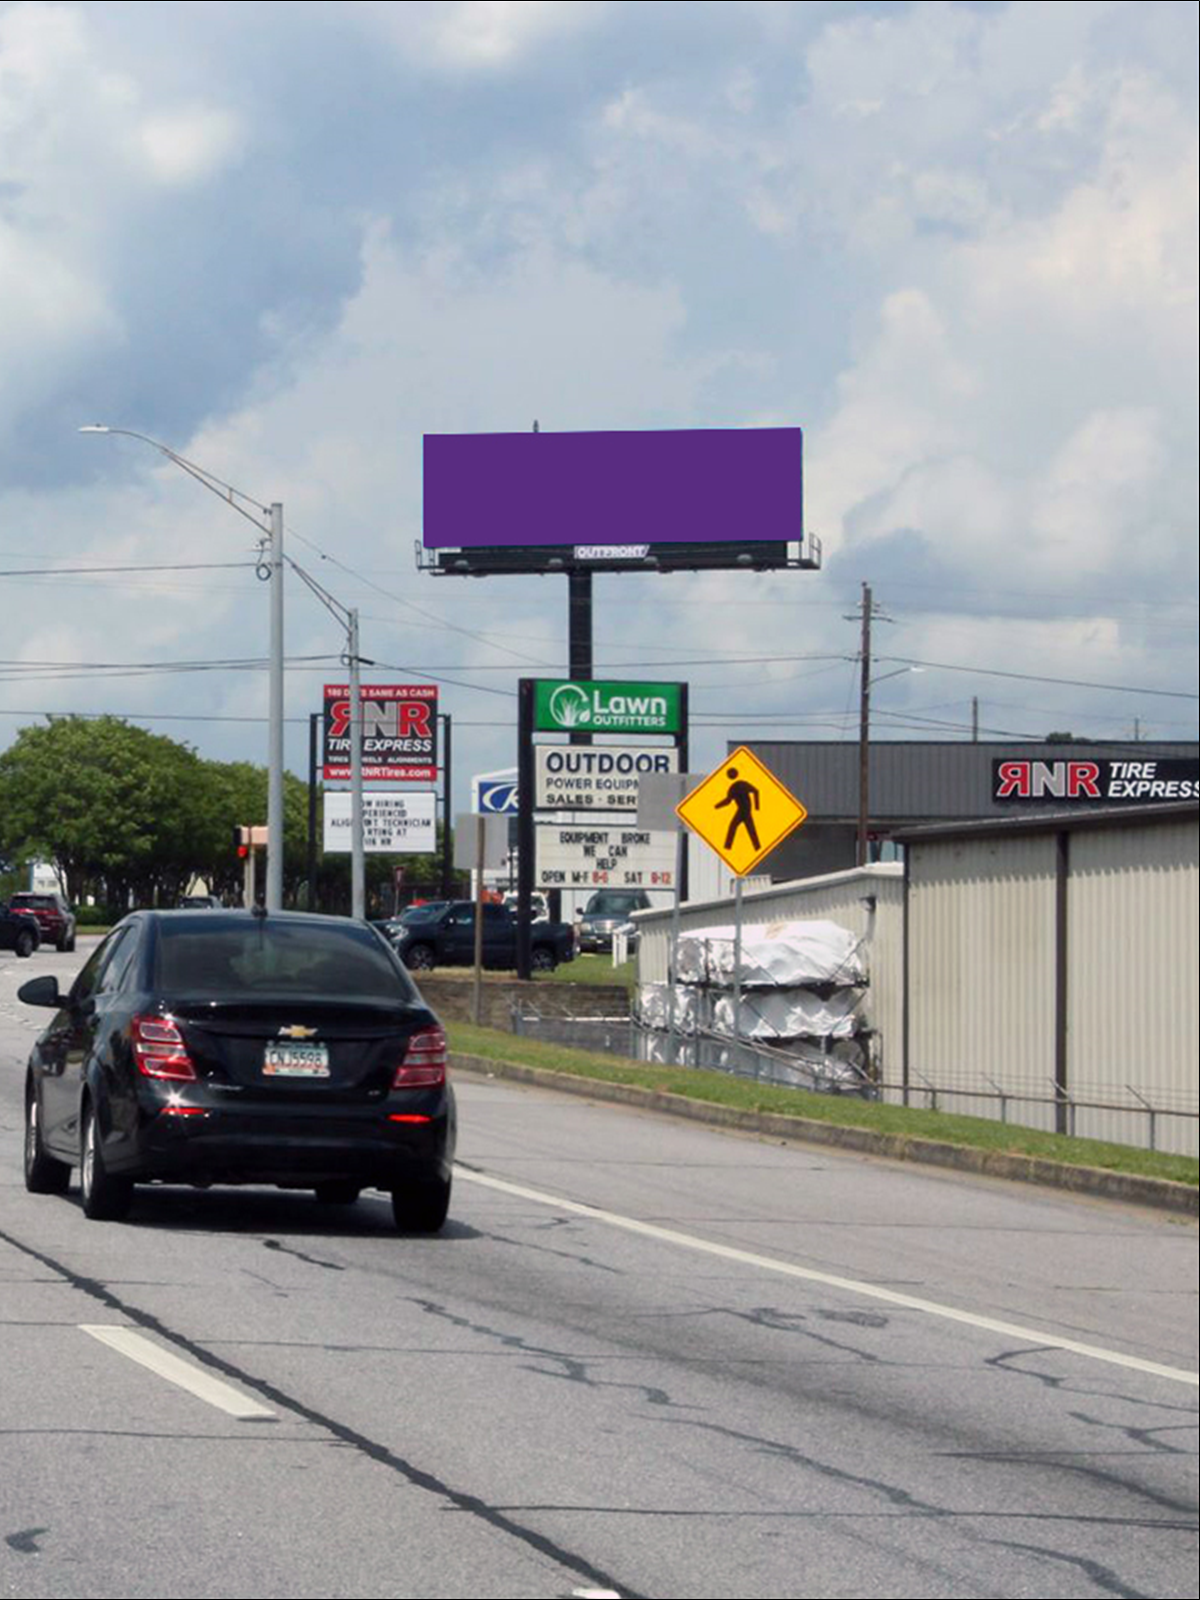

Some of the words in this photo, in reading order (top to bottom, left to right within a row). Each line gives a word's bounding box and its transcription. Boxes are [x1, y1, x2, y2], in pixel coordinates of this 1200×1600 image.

[577, 546, 646, 558] OUTFRONT
[593, 690, 667, 715] Lawn
[592, 715, 667, 727] OUTFITTERS
[328, 739, 351, 751] TIR
[363, 739, 433, 751] EXPRESS
[546, 752, 670, 774] OUTDOOR
[329, 766, 431, 777] wwwRNRTires.com
[1109, 762, 1157, 779] TIRE
[546, 777, 593, 789] POWER
[546, 793, 594, 805] SALES
[382, 819, 431, 827] TECHNICIAN
[559, 831, 609, 845] EQUIPMENT
[621, 832, 651, 845] BROKE
[583, 845, 597, 857] WE
[608, 845, 628, 857] CAN
[596, 858, 618, 870] HELP
[541, 871, 566, 884] OPEN
[624, 871, 643, 885] SAT
